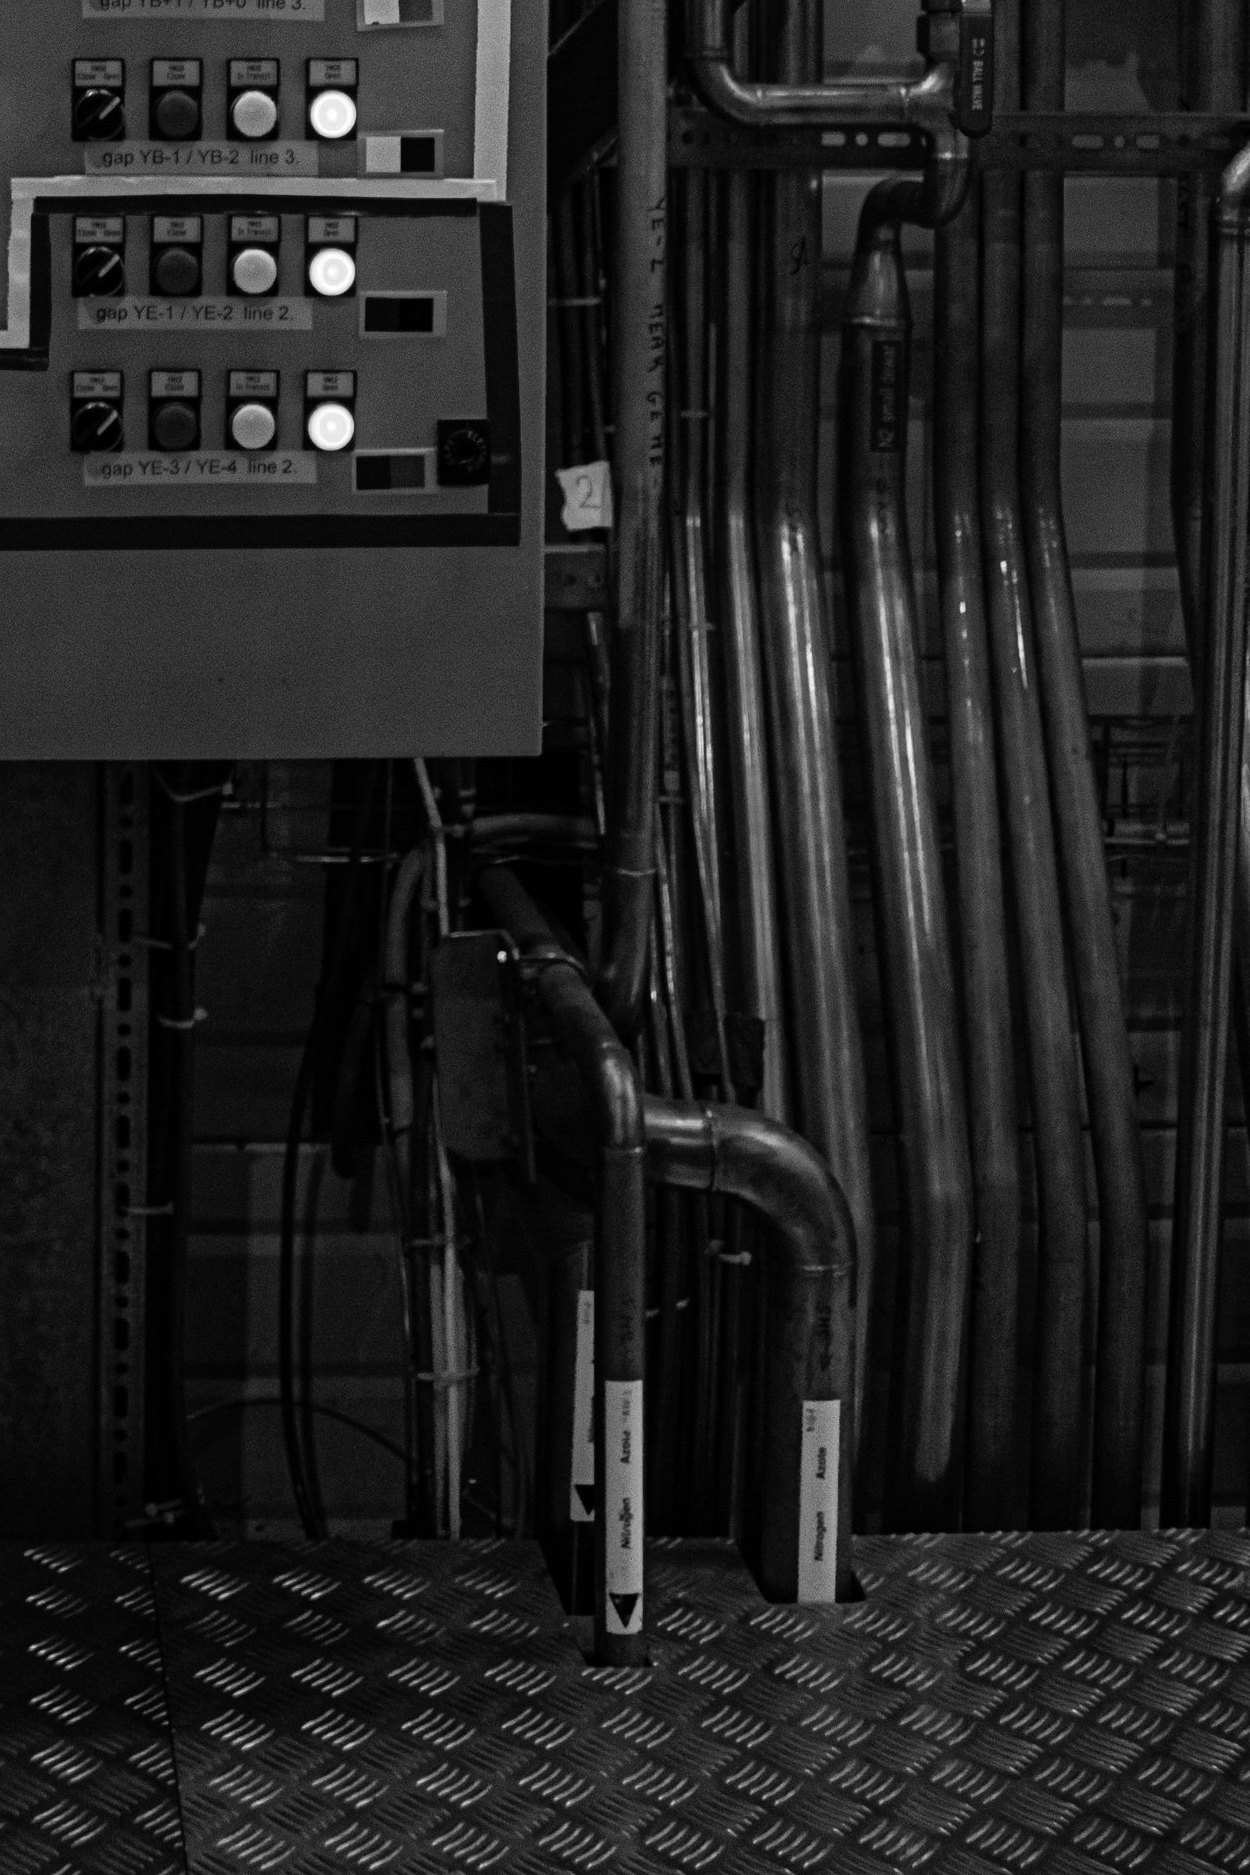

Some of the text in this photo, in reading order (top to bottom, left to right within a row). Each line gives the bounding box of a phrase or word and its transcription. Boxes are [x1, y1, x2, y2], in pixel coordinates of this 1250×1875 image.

[102, 151, 134, 167] gap
[139, 149, 180, 165] YB-1
[186, 149, 193, 165] /
[197, 149, 240, 165] YB-2
[250, 149, 279, 165] line
[96, 307, 128, 323] gap
[133, 305, 173, 320] YE-1
[180, 305, 187, 320] /
[192, 305, 233, 321] YE-2
[243, 306, 274, 321] line
[101, 463, 134, 479] gap
[138, 460, 180, 475] YE-3
[184, 460, 191, 475] /
[196, 459, 237, 474] YE-4
[247, 460, 278, 475] line
[575, 474, 602, 510] 2
[813, 1447, 827, 1562] Nitrogen Azote
[619, 1497, 634, 1550] Nitrogen
